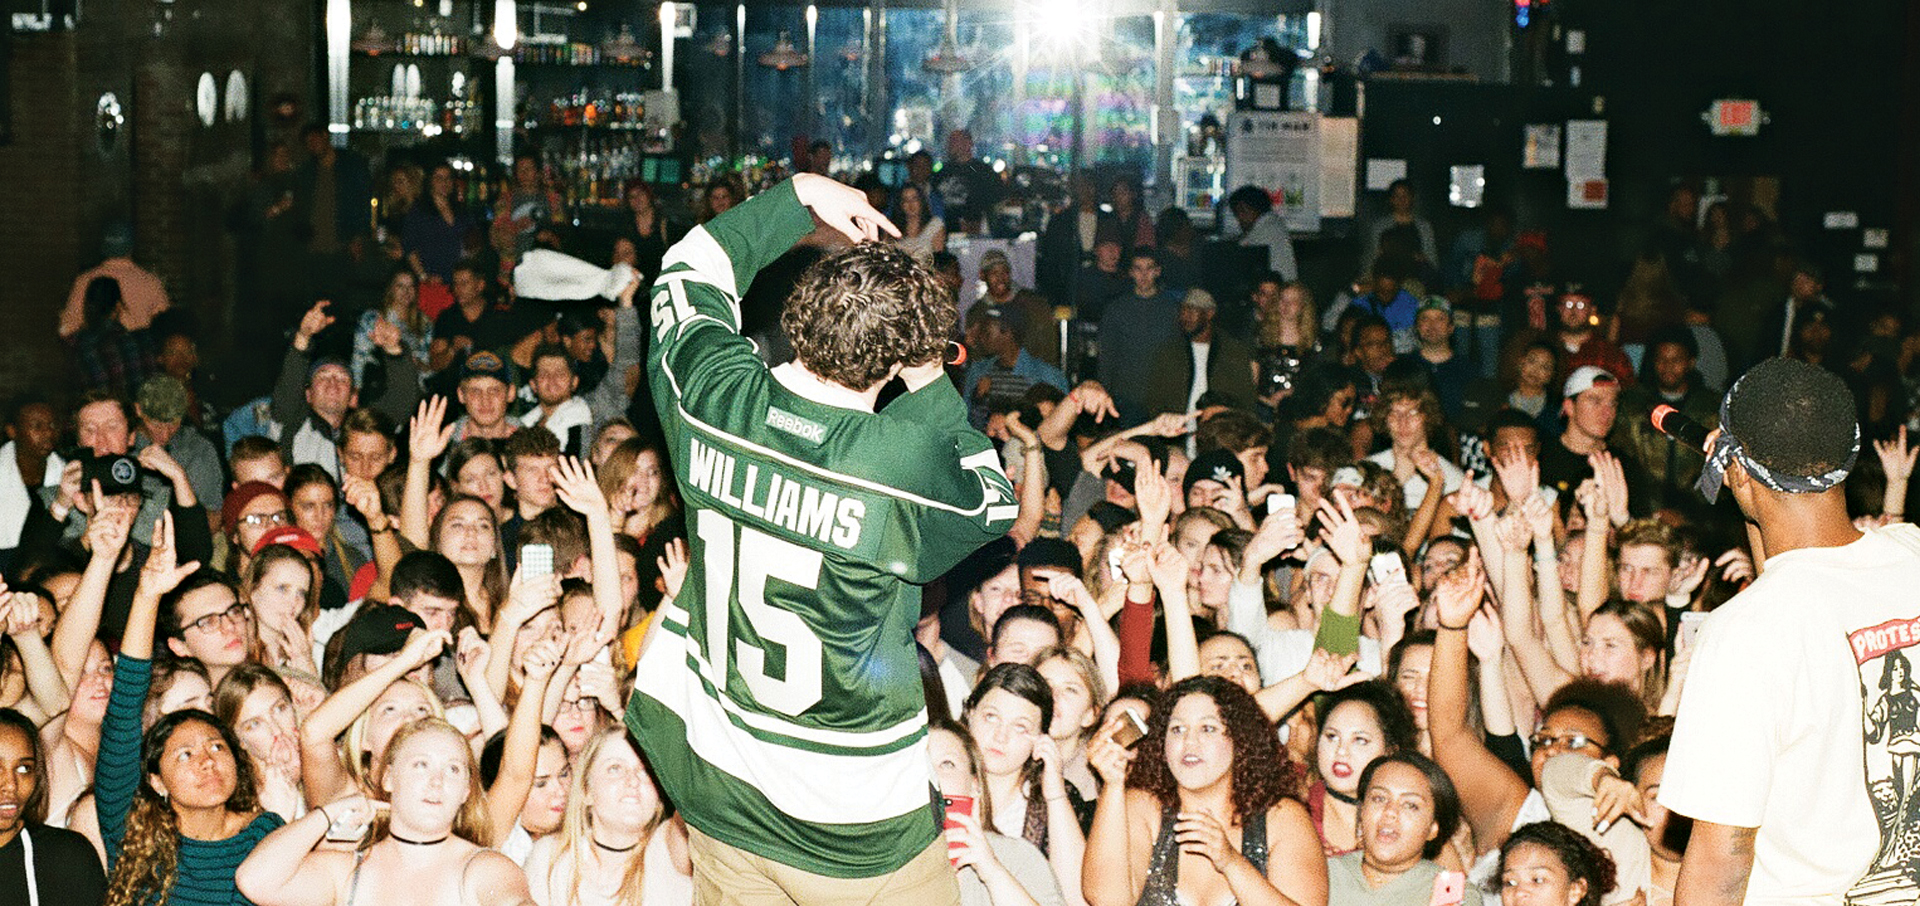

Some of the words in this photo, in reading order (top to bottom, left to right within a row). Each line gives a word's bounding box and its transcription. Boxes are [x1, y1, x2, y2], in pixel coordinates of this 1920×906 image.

[766, 409, 825, 444] Reebok
[688, 437, 866, 550] WILLIAMS
[697, 508, 824, 717] 15
[1853, 618, 1920, 660] PROTES
